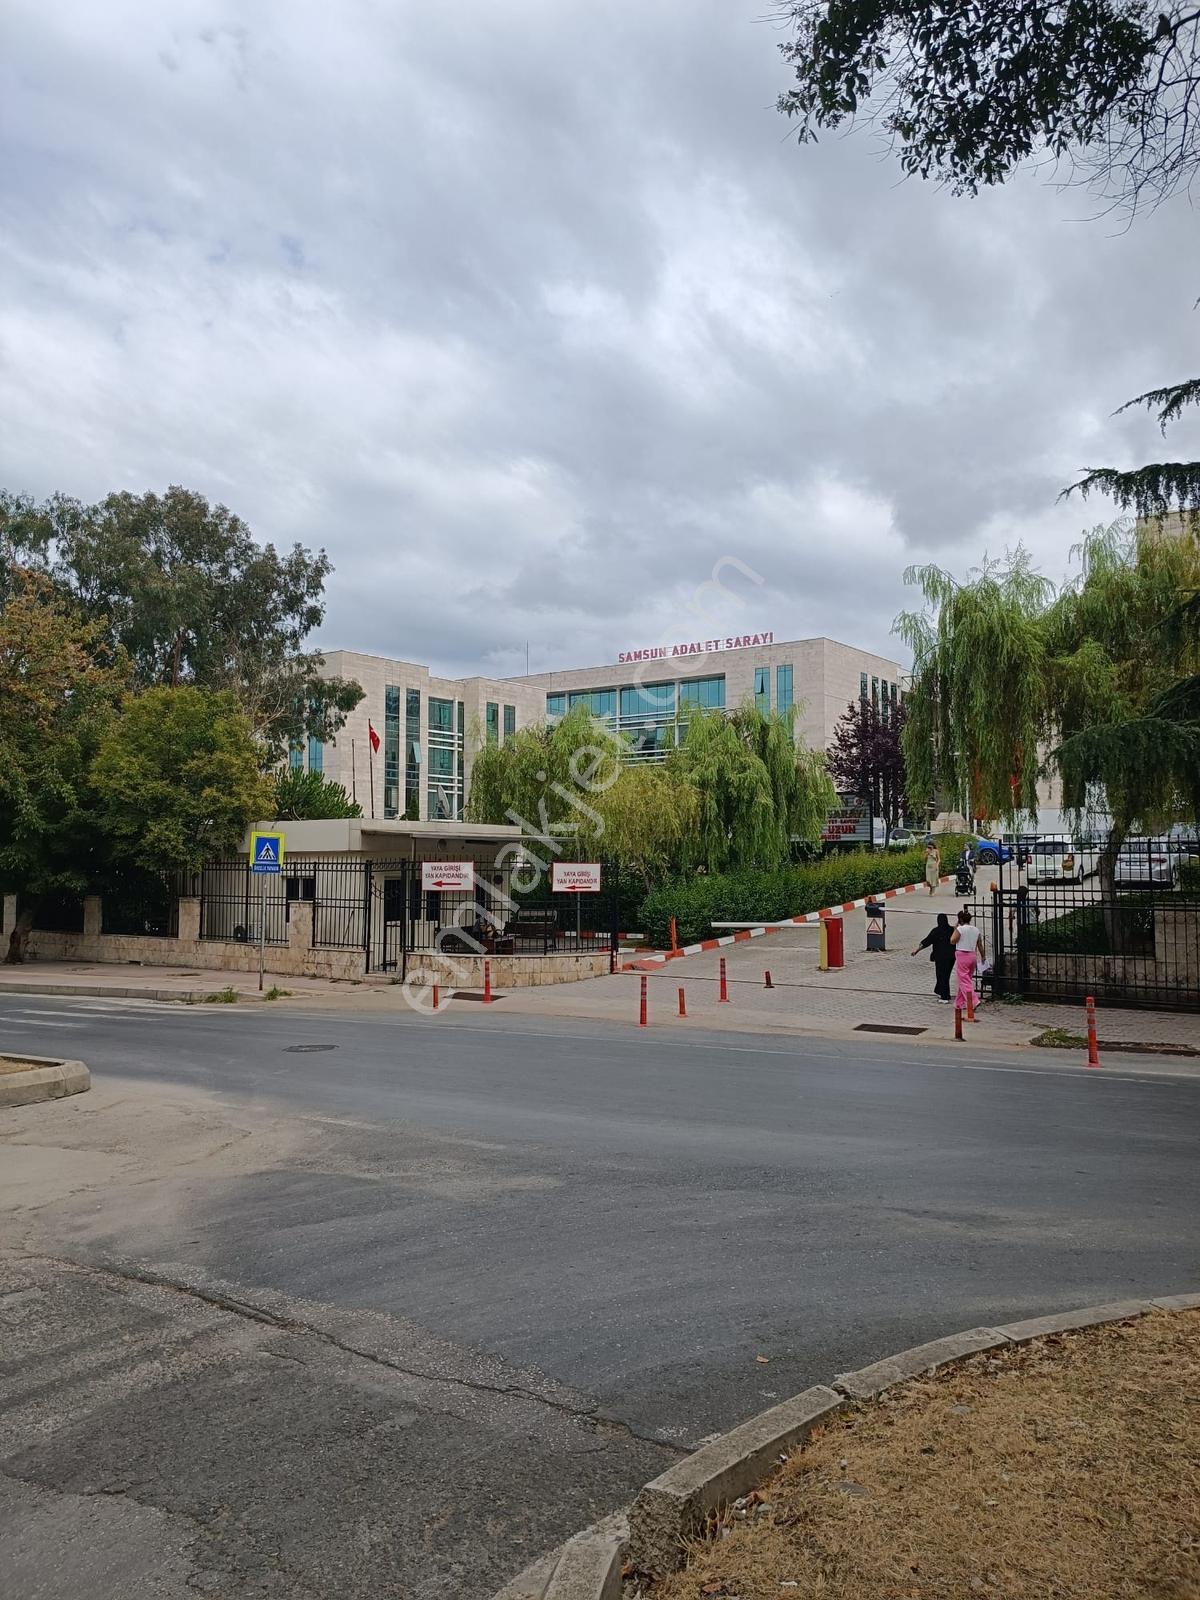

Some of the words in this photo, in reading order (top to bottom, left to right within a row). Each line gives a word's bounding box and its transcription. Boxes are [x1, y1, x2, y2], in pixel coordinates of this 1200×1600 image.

[618, 647, 667, 663] SAMSUN
[672, 640, 721, 656] ADALET
[725, 632, 774, 648] SARAYI
